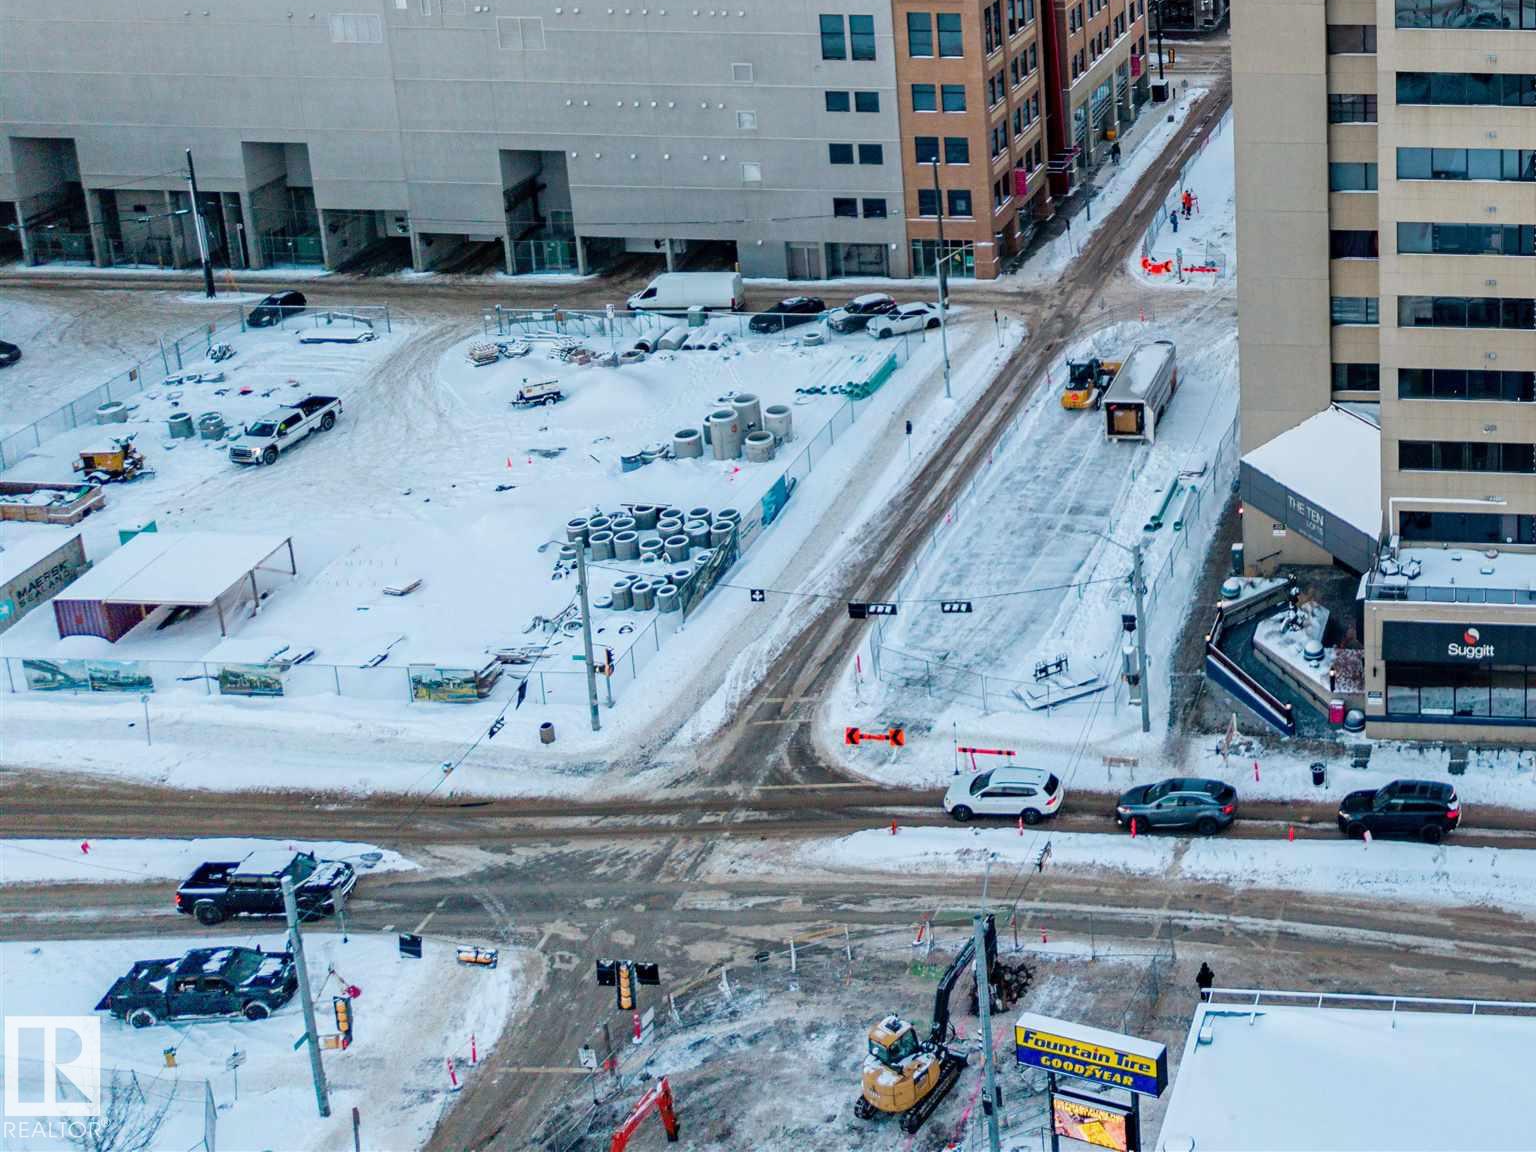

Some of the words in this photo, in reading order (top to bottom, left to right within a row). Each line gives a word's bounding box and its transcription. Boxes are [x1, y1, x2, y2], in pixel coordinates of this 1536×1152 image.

[1288, 495, 1304, 516] THE
[1306, 506, 1324, 527] TEN
[16, 559, 69, 599] MAERSK
[1448, 643, 1495, 659] Suggitt
[1023, 1031, 1111, 1064] Fountain
[1114, 1051, 1152, 1073] Tire
[1040, 1055, 1134, 1086] GOODYEAR
